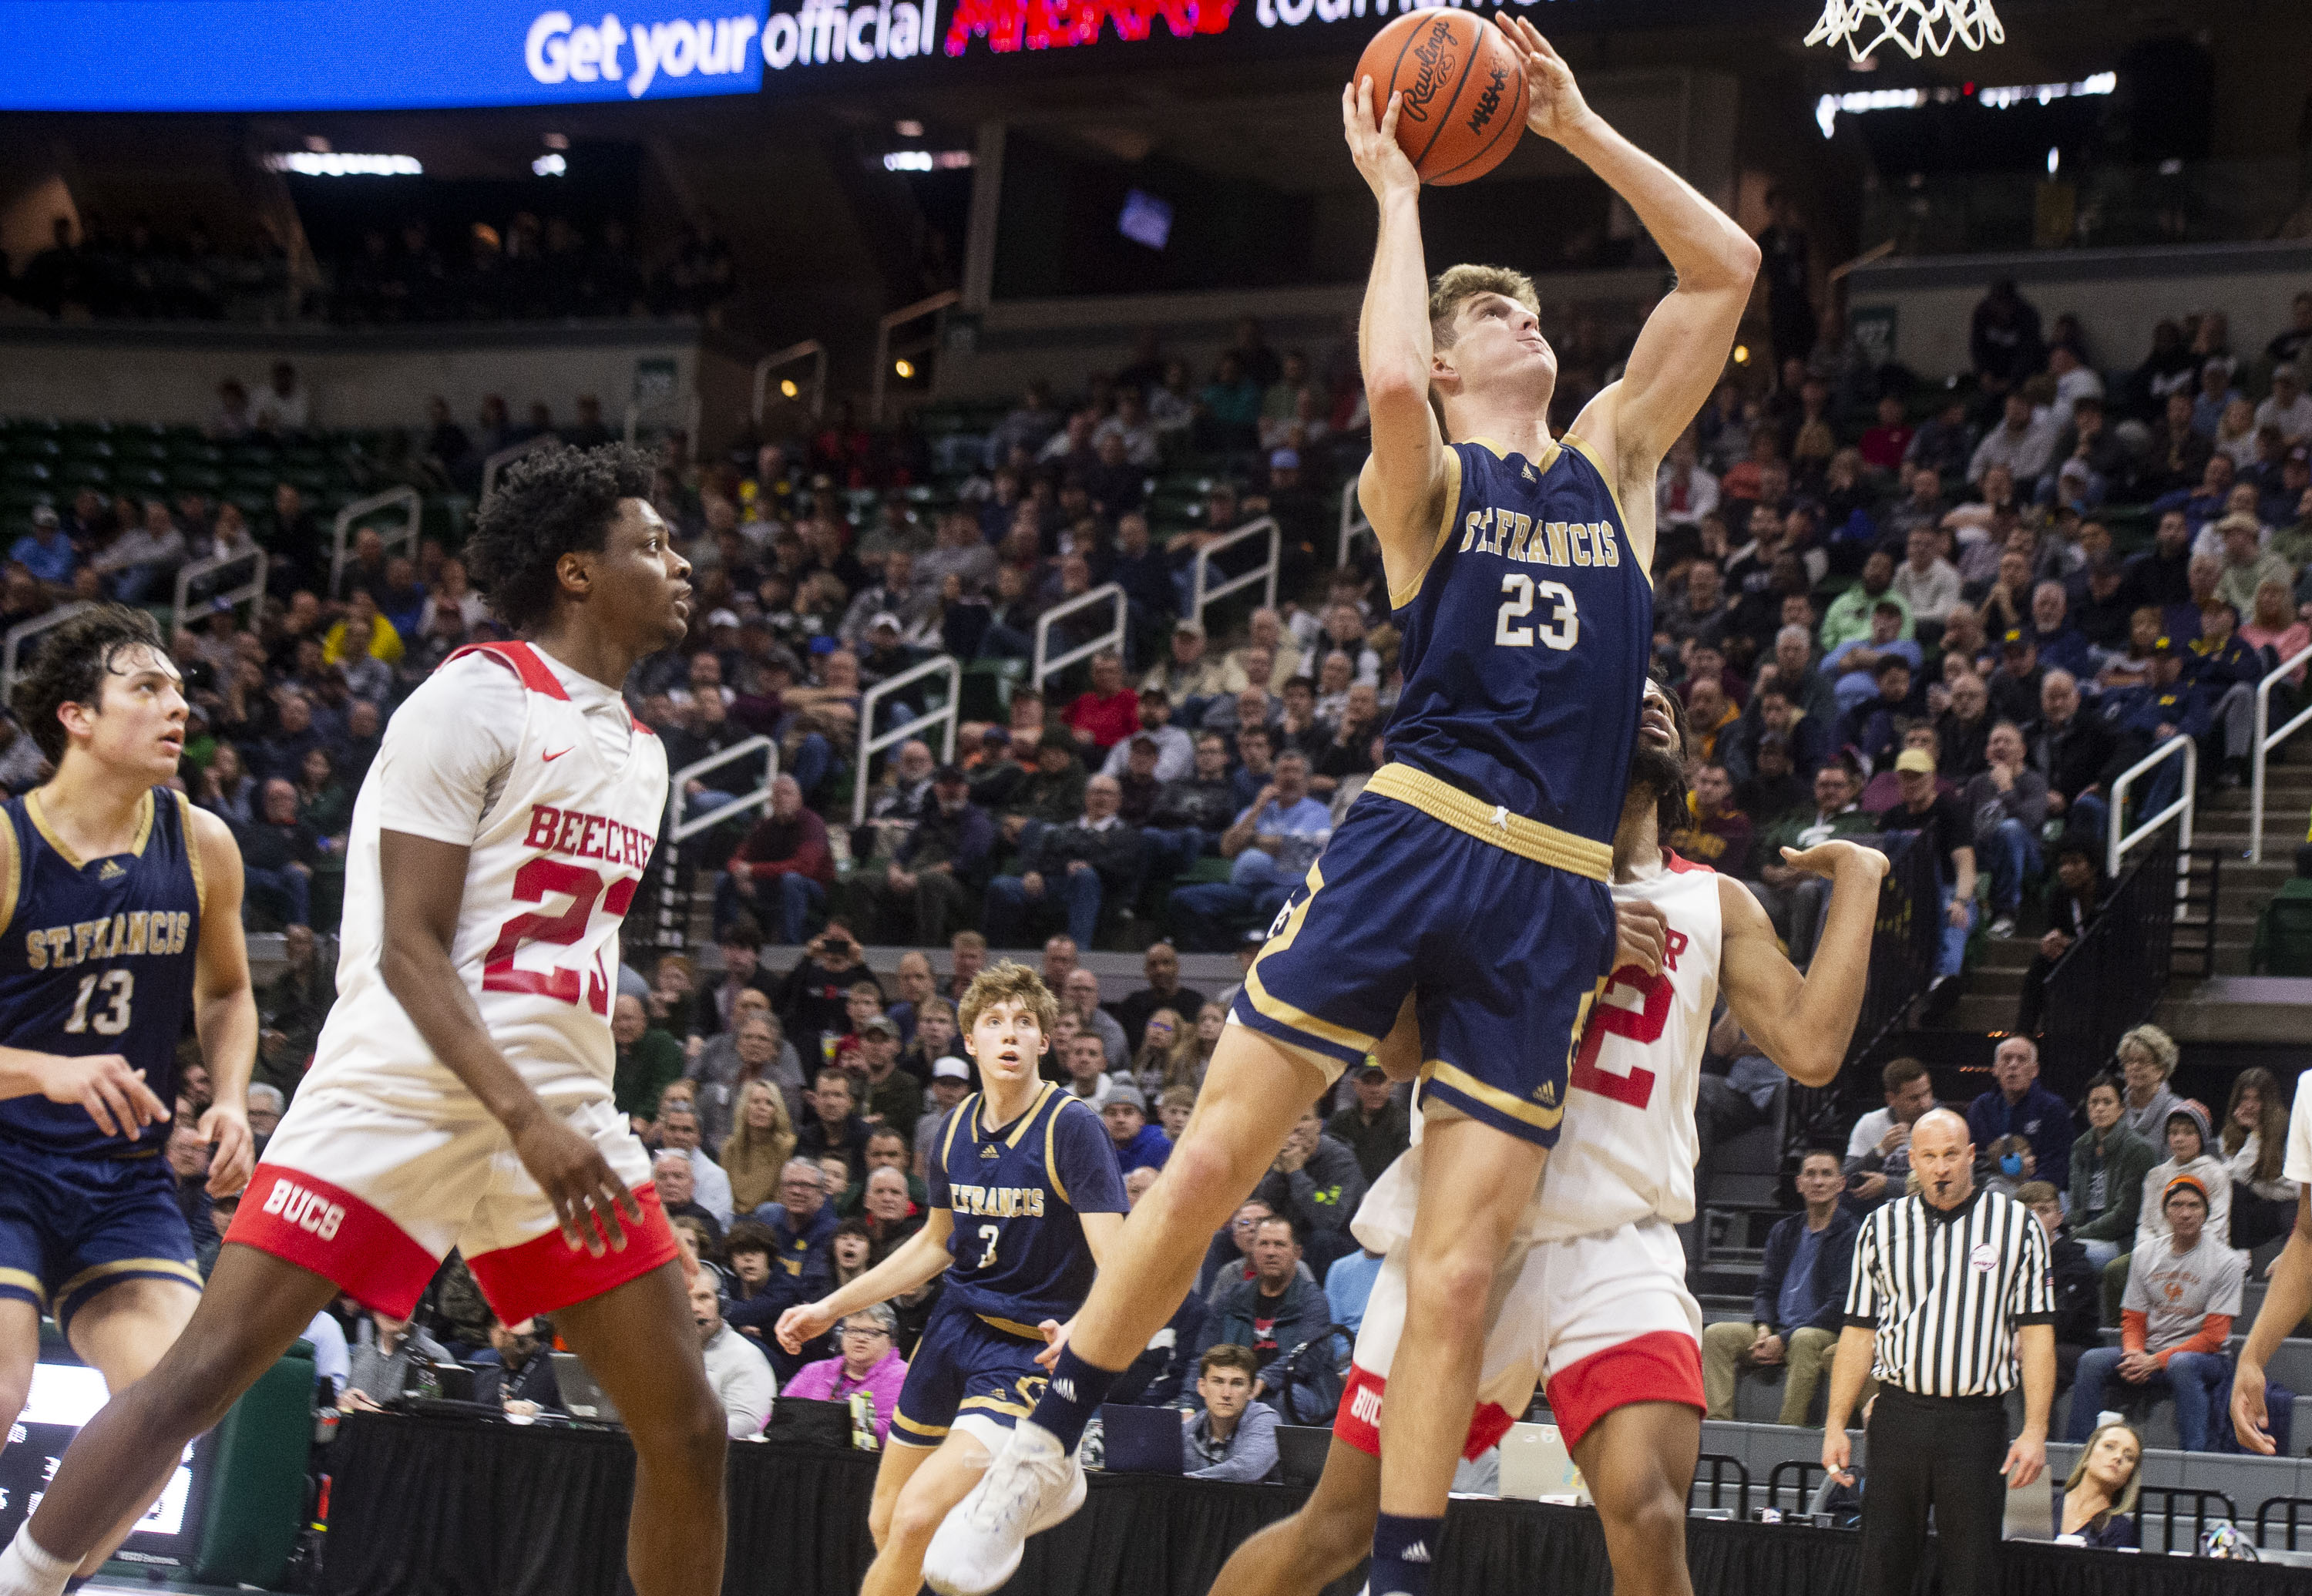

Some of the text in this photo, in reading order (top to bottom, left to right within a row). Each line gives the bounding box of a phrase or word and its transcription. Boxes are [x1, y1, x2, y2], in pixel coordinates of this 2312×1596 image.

[526, 12, 626, 83] Get
[627, 15, 757, 98] your
[761, 0, 939, 69] official
[1403, 22, 1458, 123] Rawlings
[1459, 507, 1619, 567] ST.FRANCIS
[1495, 573, 1579, 651] 23
[523, 804, 655, 872] BEECHE
[26, 911, 190, 970] ST.FRANCIS
[65, 969, 134, 1035] 13
[263, 1178, 346, 1242] BUCS
[977, 1224, 1000, 1268] 3
[1350, 1384, 1383, 1428] BUC
